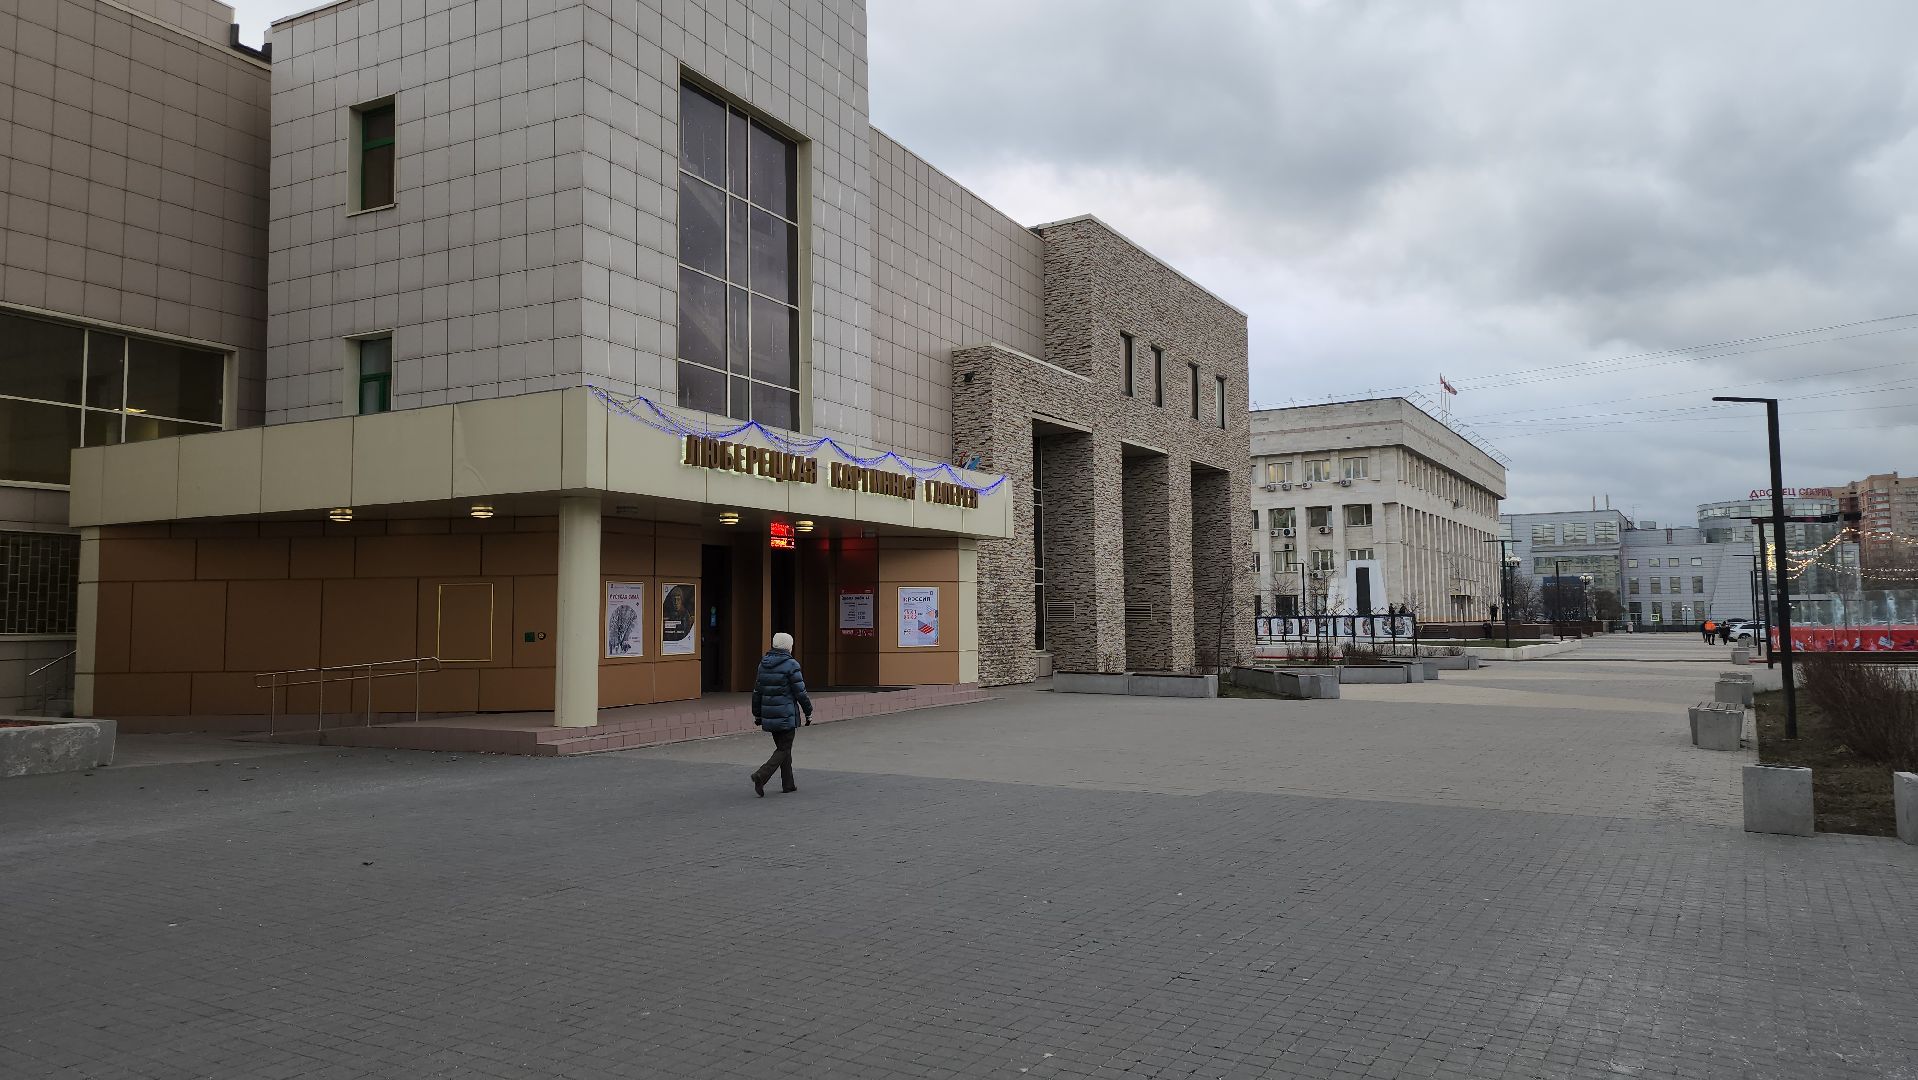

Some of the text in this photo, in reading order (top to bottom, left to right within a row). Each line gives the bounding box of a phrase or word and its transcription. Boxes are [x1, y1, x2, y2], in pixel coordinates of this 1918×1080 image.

[683, 434, 979, 509] ЛЮБЕРЕЦКАЯ КАРТИННАЯ ГАЛЕРЕЯ
[1749, 487, 1795, 499] ДВОЕЦ
